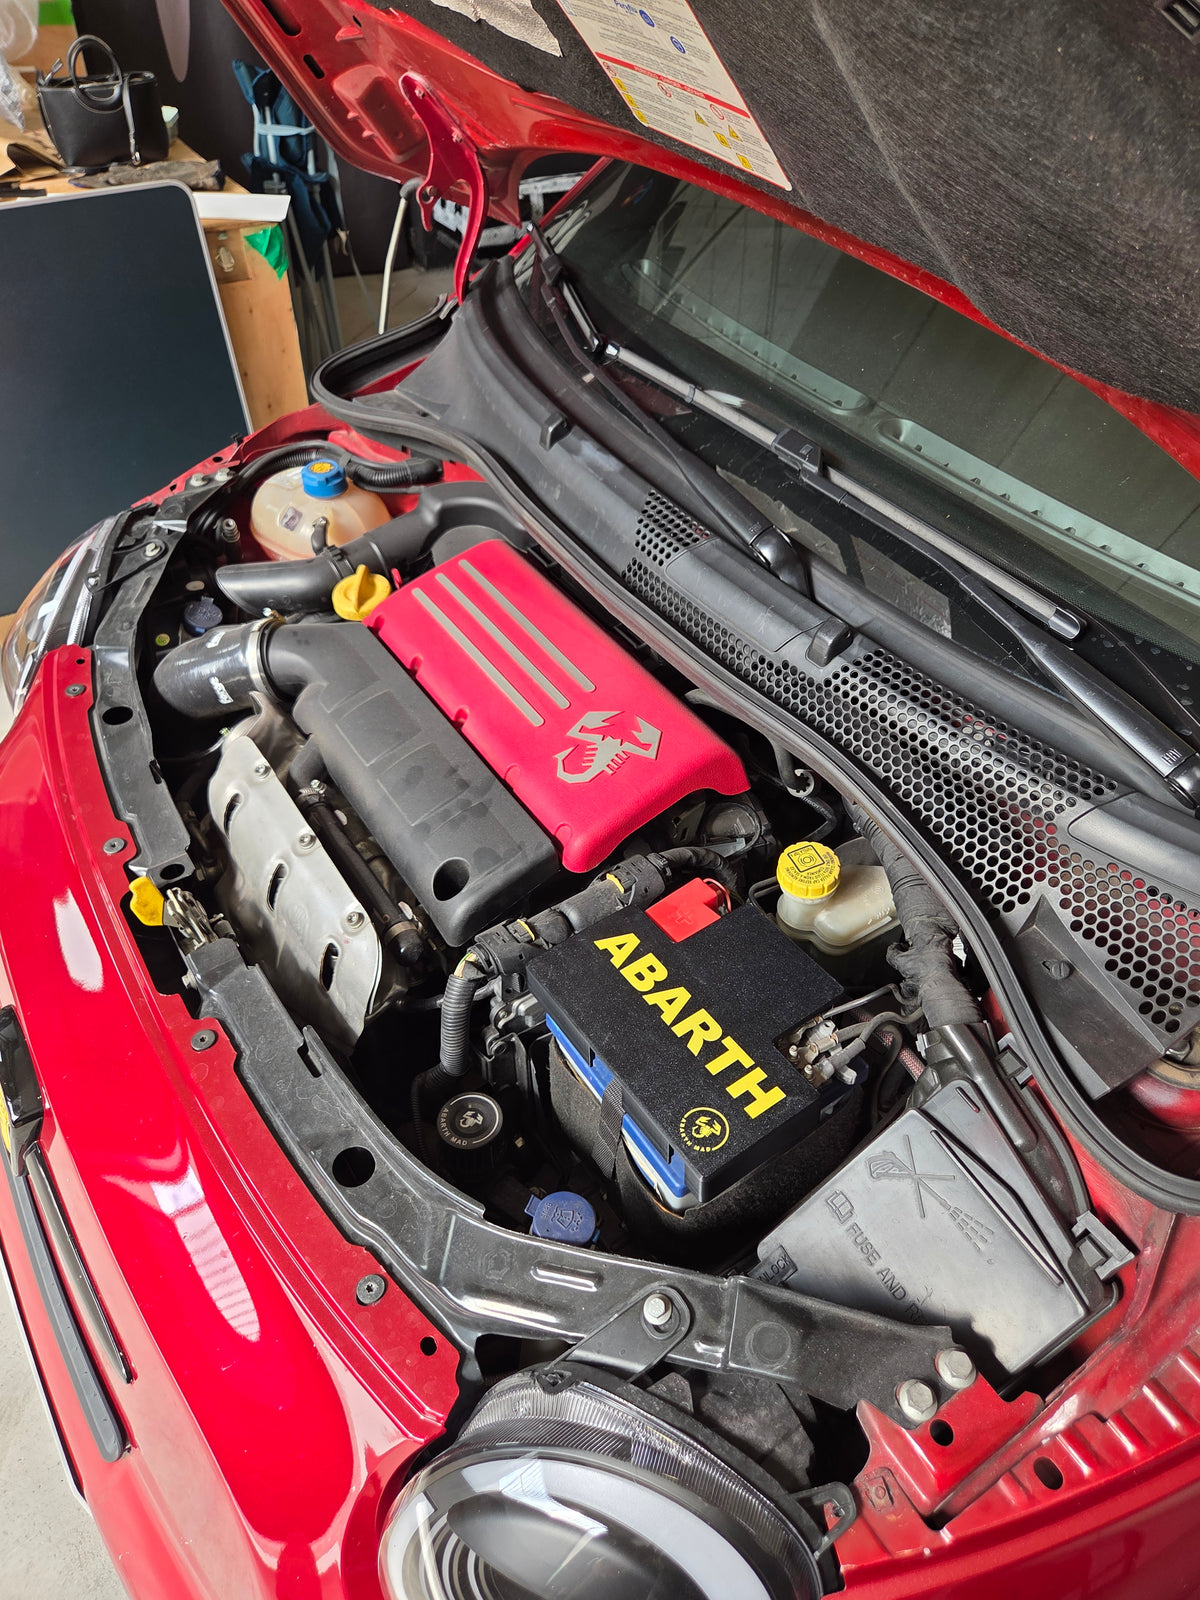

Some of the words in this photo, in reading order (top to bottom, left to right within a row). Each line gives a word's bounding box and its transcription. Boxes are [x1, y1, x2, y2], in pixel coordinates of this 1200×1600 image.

[593, 932, 787, 1120] ABARTH
[440, 1107, 450, 1138] ABARTH
[450, 1136, 468, 1146] MAD
[680, 1117, 693, 1147] ABARTH
[693, 1144, 711, 1152] MAD
[757, 1253, 791, 1283] NLOCK
[847, 1222, 882, 1267] FUSE
[878, 1267, 907, 1301] AND
